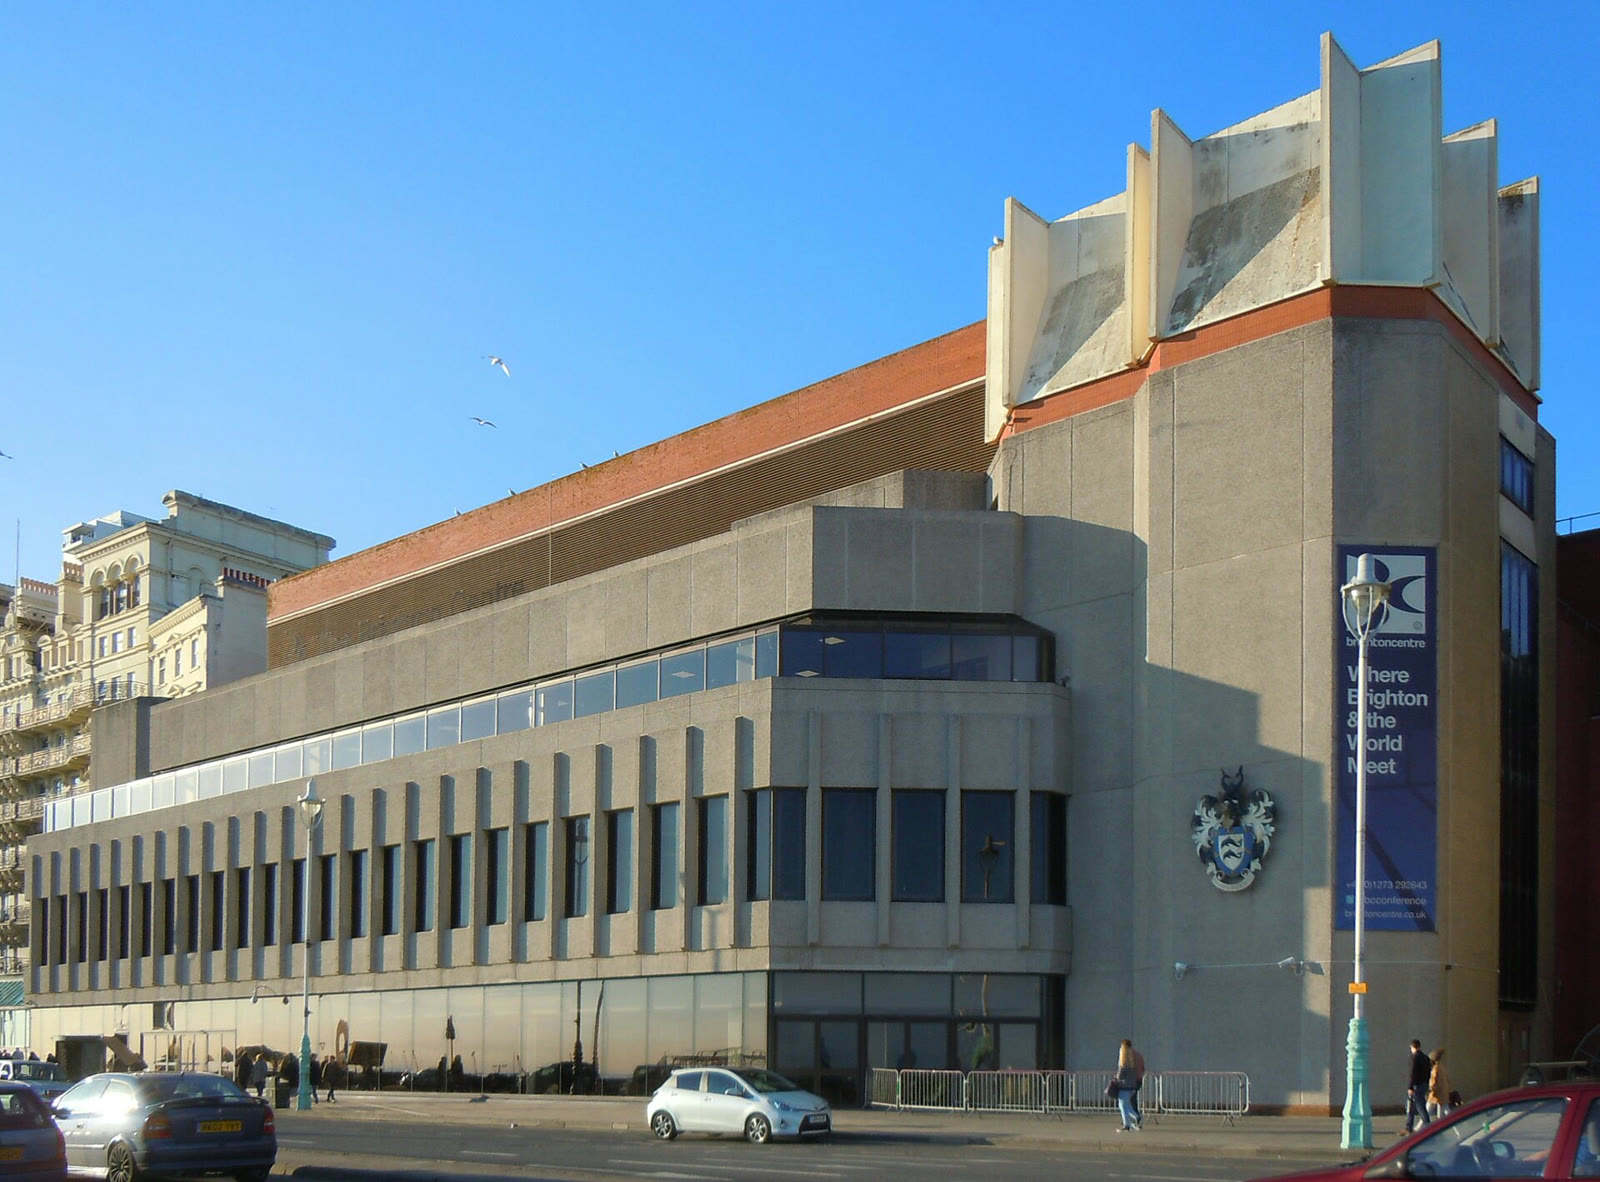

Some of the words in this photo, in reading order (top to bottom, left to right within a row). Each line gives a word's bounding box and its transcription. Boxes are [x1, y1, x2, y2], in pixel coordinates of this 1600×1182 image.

[1345, 637, 1426, 648] brhtoncentre
[1347, 688, 1428, 710] Bighton
[1366, 711, 1397, 729] the
